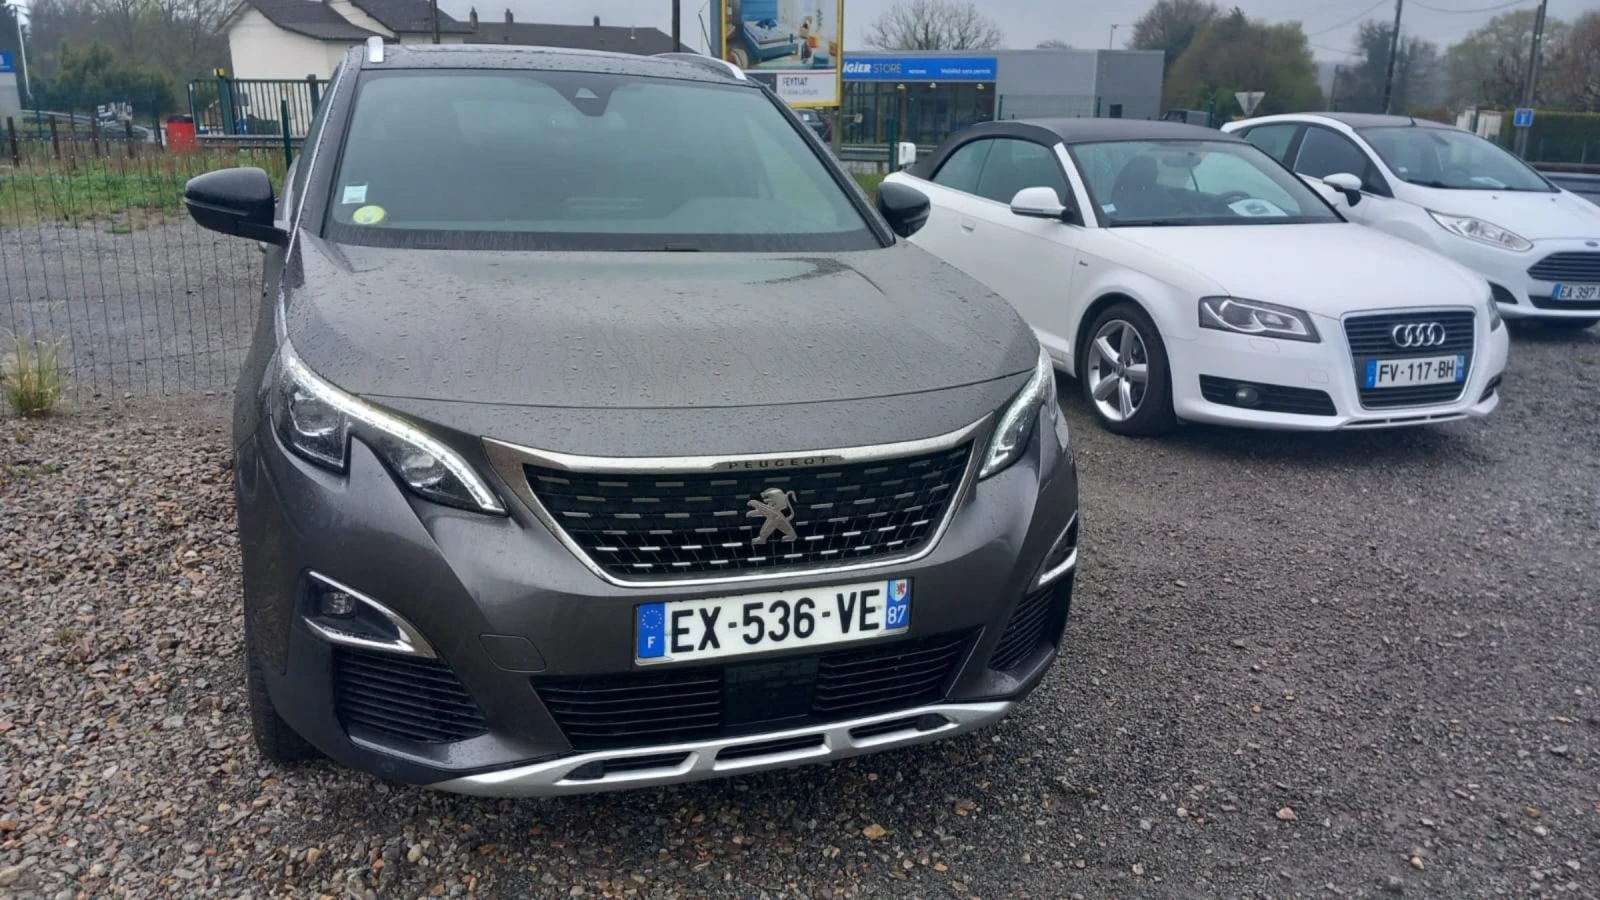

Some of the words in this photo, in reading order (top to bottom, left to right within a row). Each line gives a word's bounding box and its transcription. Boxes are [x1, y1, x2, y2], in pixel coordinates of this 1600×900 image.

[873, 64, 902, 74] STORE
[783, 77, 808, 87] FEYTIAT
[1379, 360, 1455, 383] FV-117-BH
[728, 457, 830, 470] PEUGEOT
[647, 636, 656, 649] F
[671, 589, 880, 653] EX-536-VE
[888, 604, 907, 625] 87
